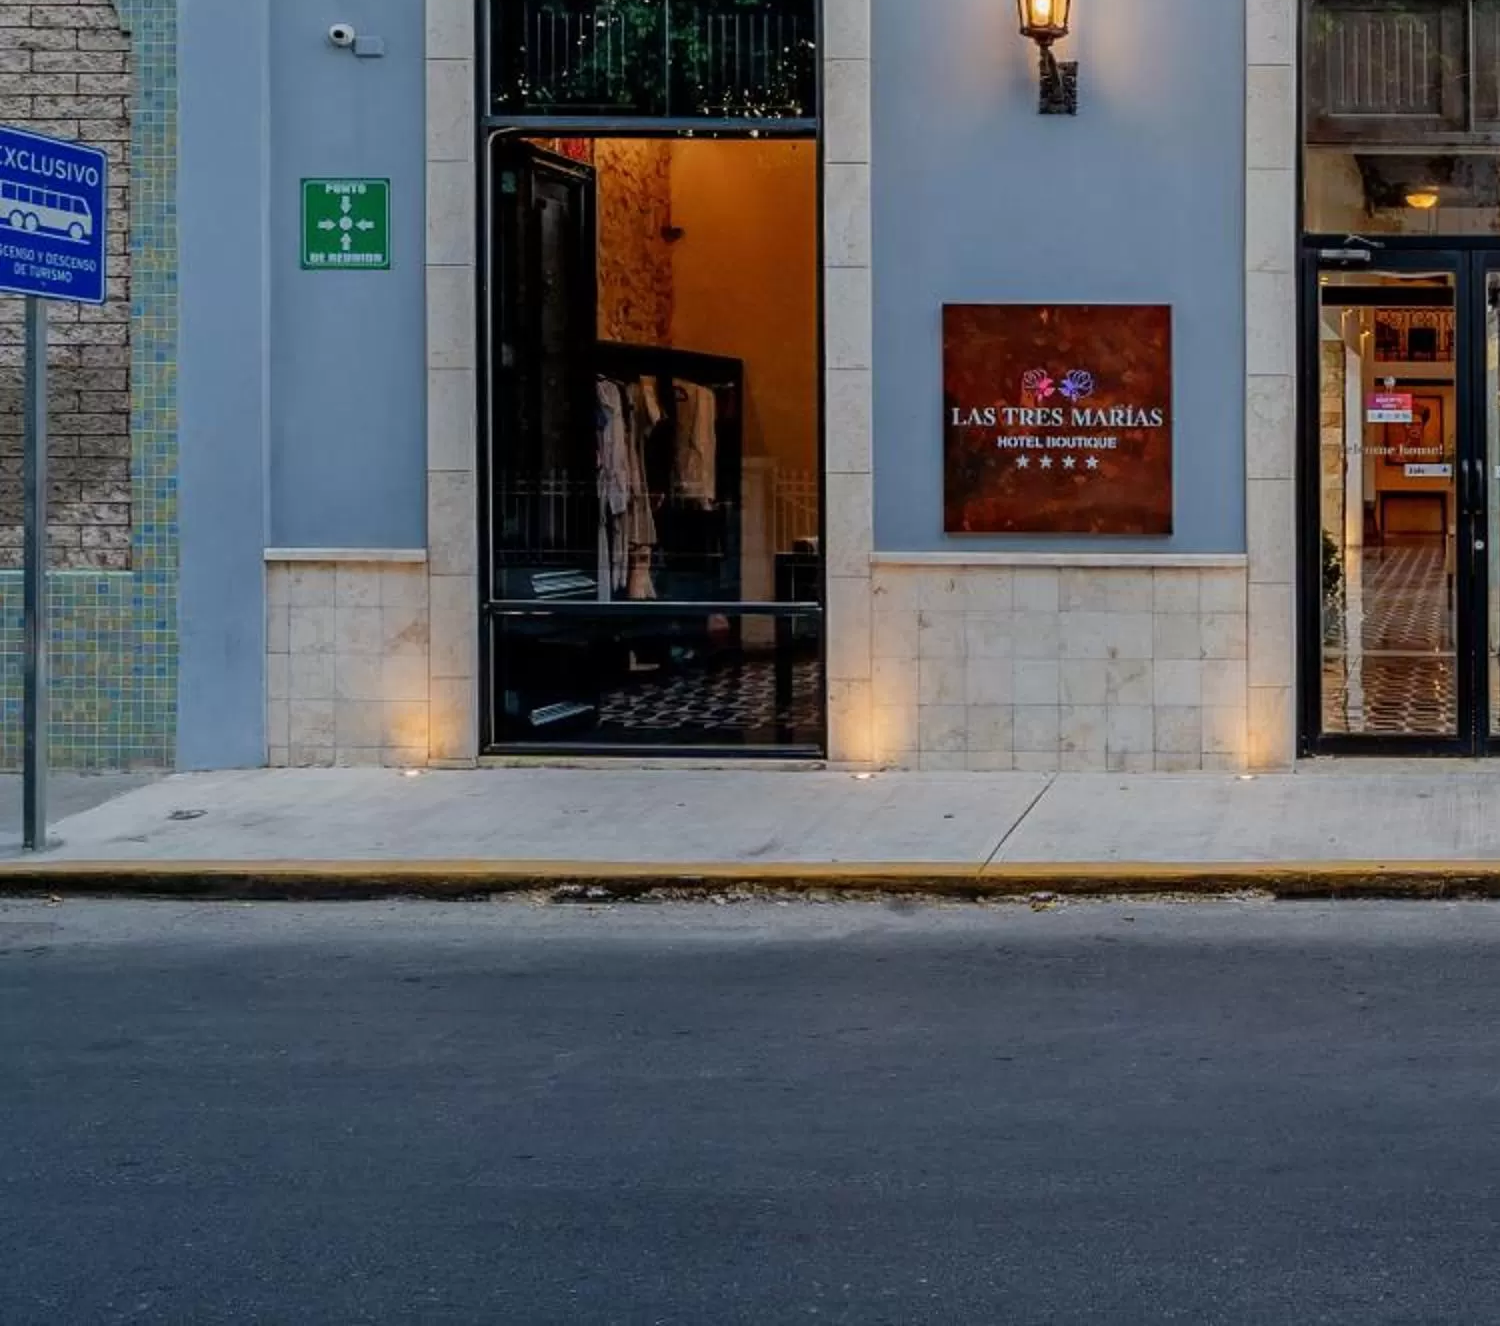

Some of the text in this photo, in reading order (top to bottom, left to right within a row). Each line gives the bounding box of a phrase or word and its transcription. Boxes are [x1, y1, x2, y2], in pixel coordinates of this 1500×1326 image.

[37, 251, 44, 263] Y
[45, 251, 97, 272] DESCENSO
[13, 261, 73, 283] DE TURISMO
[952, 407, 996, 426] LAS
[1002, 407, 1063, 426] TRES
[998, 436, 1117, 449] HOTEL BOUTIQUE
